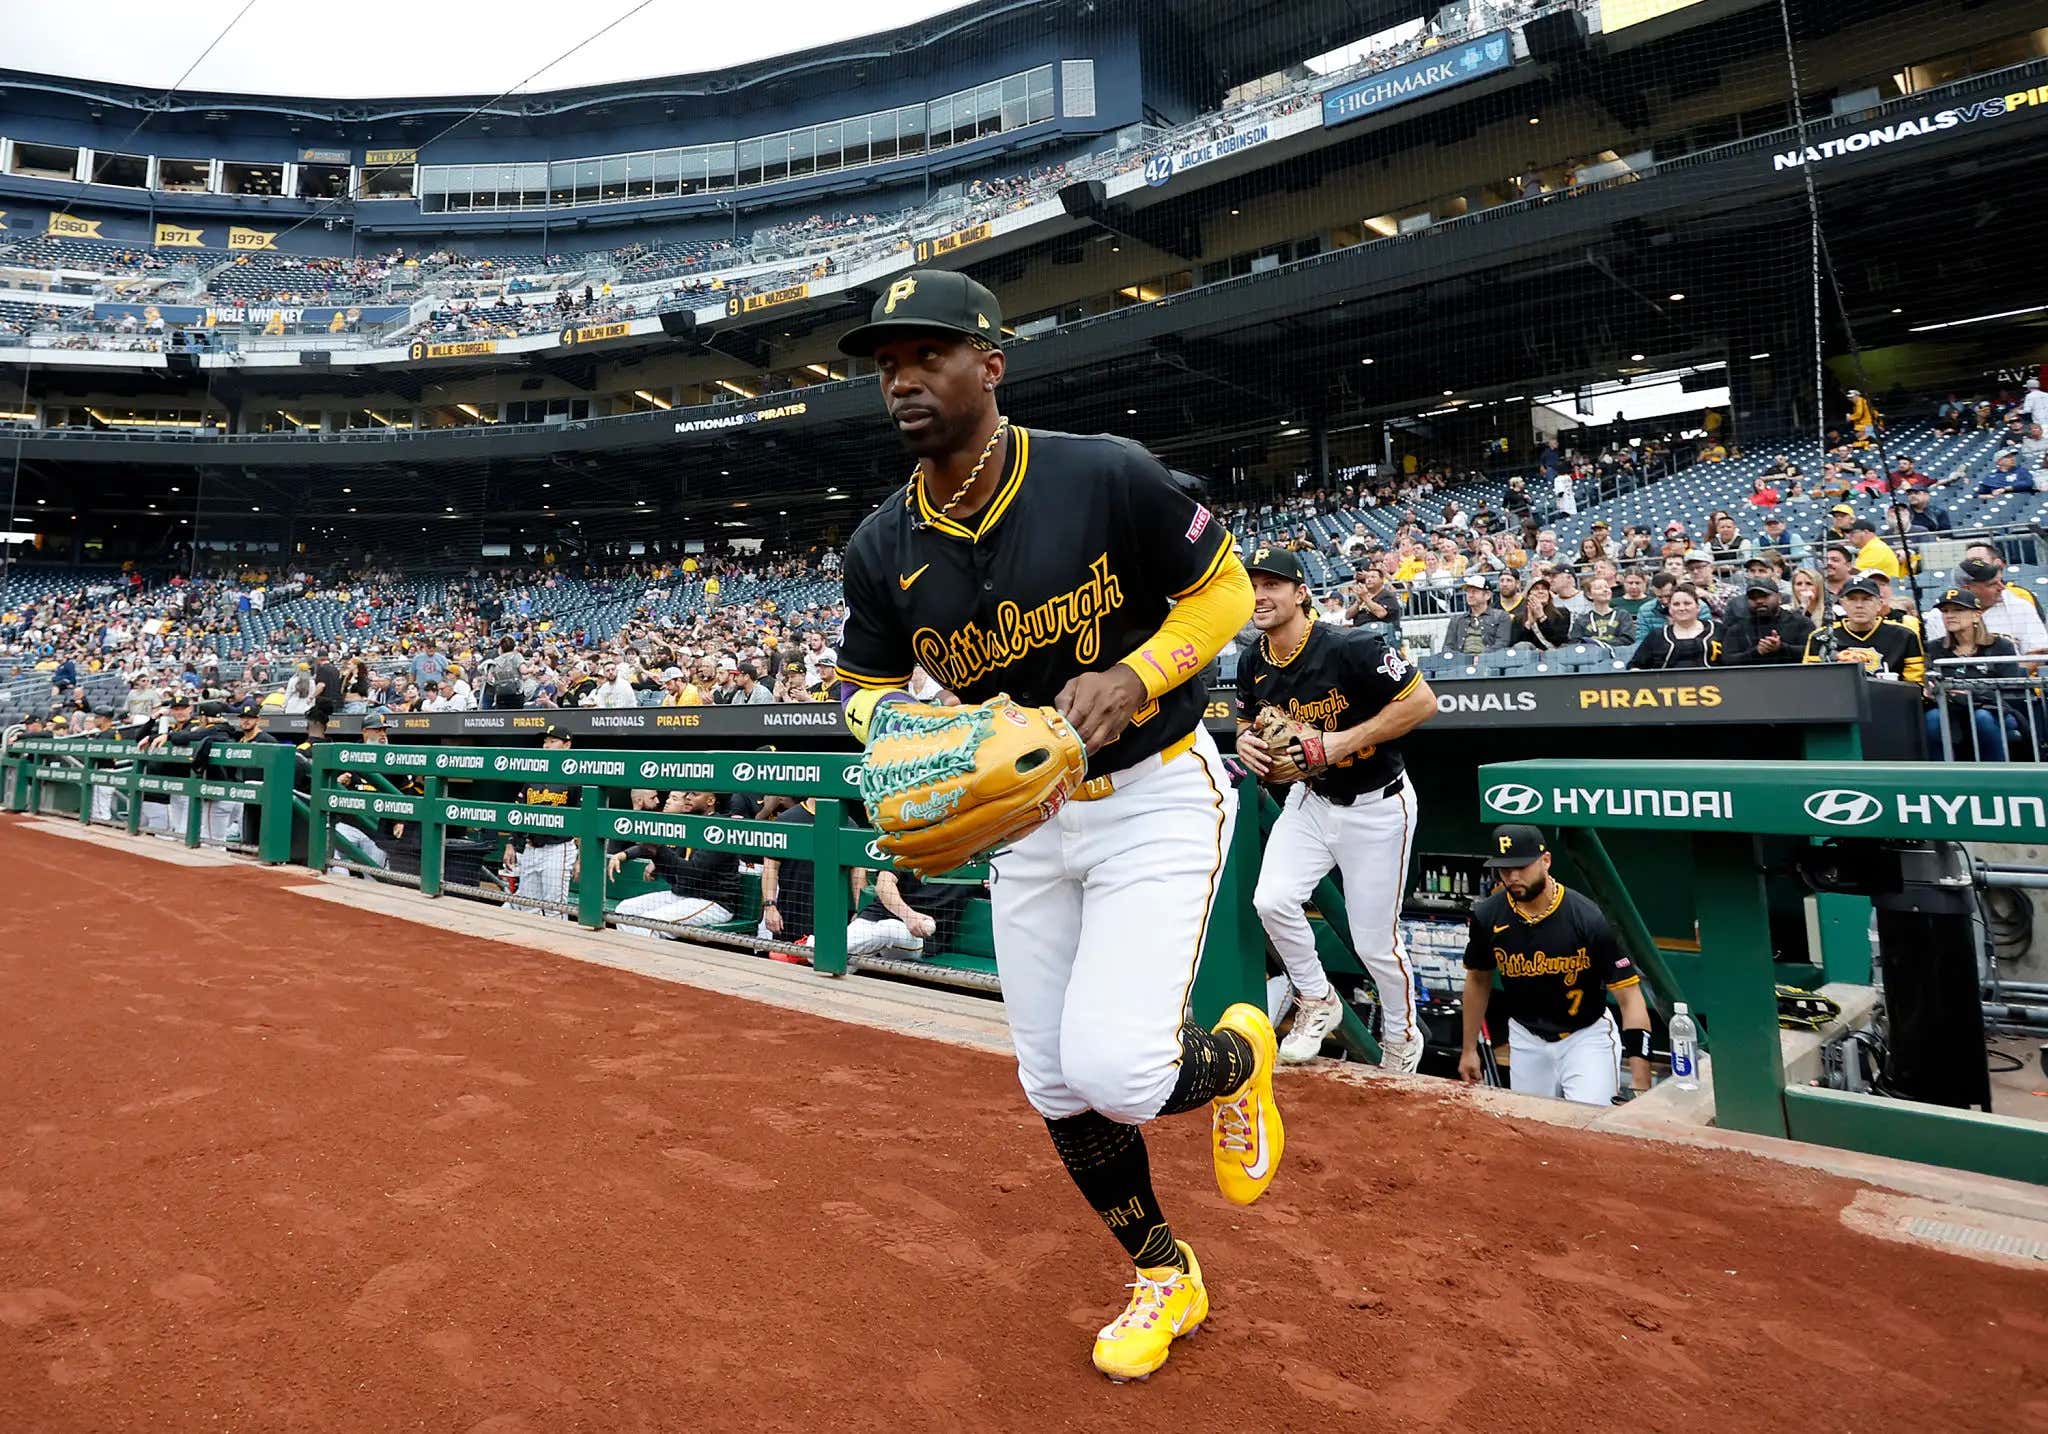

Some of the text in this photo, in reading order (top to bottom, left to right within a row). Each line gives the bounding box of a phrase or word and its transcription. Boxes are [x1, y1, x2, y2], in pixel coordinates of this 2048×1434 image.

[1339, 60, 1452, 115] HIGHMARK
[1145, 127, 1268, 181] 42 JACKIE ROBINSON
[54, 219, 88, 233] 1960
[161, 230, 190, 243] 1971
[232, 234, 265, 245] 1979
[917, 243, 928, 260] 11
[884, 275, 918, 314] P
[728, 297, 739, 317] 9
[563, 329, 572, 345] 4
[412, 343, 423, 361] 8
[675, 414, 743, 433] NATIONALS
[757, 402, 807, 421] PIRATES
[1253, 548, 1271, 565] P
[1946, 590, 1959, 600] P
[912, 551, 1124, 691] Pittsburgh
[1171, 643, 1199, 674] 22
[1579, 685, 1723, 709] PIRATES
[405, 719, 431, 728] PIRATES
[464, 717, 545, 728] NATIONALS PIRATES
[591, 714, 700, 727] NATIONALS PIRATES
[764, 713, 837, 726] NATIONALS
[350, 752, 377, 763] HYUNDAI
[396, 754, 427, 766] HYUNDAI
[449, 756, 485, 769] HYUNDAI
[509, 758, 549, 772] HYUNDAI
[579, 761, 625, 776] HYUNDAI
[661, 763, 714, 778] HYUNDAI
[757, 765, 820, 782] HYUNDAI
[1086, 776, 1108, 794] 22
[339, 797, 366, 809] HYUNDAI
[384, 801, 414, 814] HYUNDAI
[1553, 788, 1733, 818] HYUNDAI
[460, 807, 496, 822] HYUNDAI
[524, 813, 564, 828] HYUNDAI
[634, 820, 686, 839] HYUNDAI
[727, 829, 787, 849] HYUNDAI
[1499, 835, 1513, 854] P
[1494, 947, 1591, 987] Pittsburgh
[1567, 989, 1584, 1016] 7
